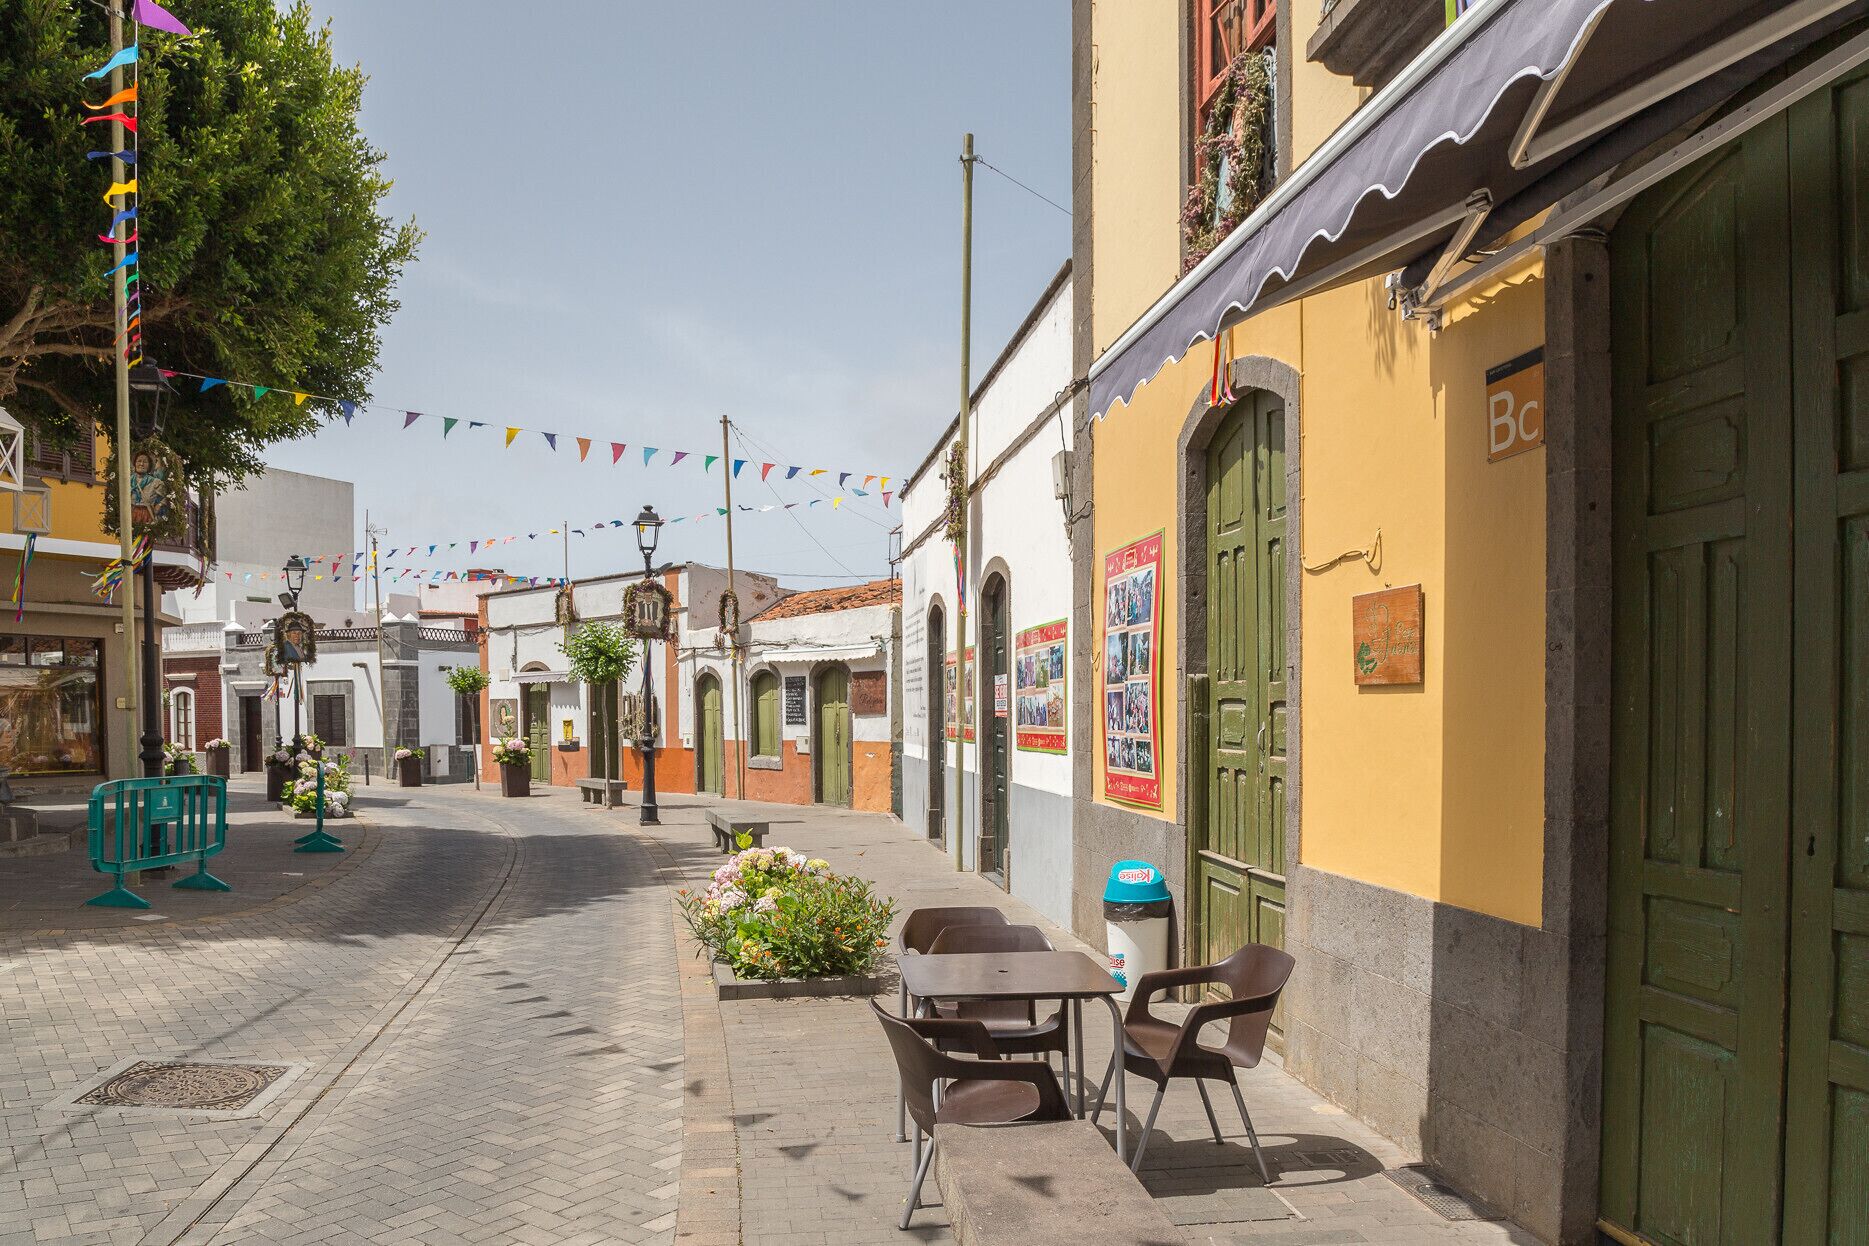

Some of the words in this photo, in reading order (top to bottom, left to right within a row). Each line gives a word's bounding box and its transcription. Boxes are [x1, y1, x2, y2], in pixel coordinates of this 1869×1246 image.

[1490, 391, 1538, 453] Bc
[1120, 869, 1150, 882] Kalise
[1109, 957, 1125, 966] alise
